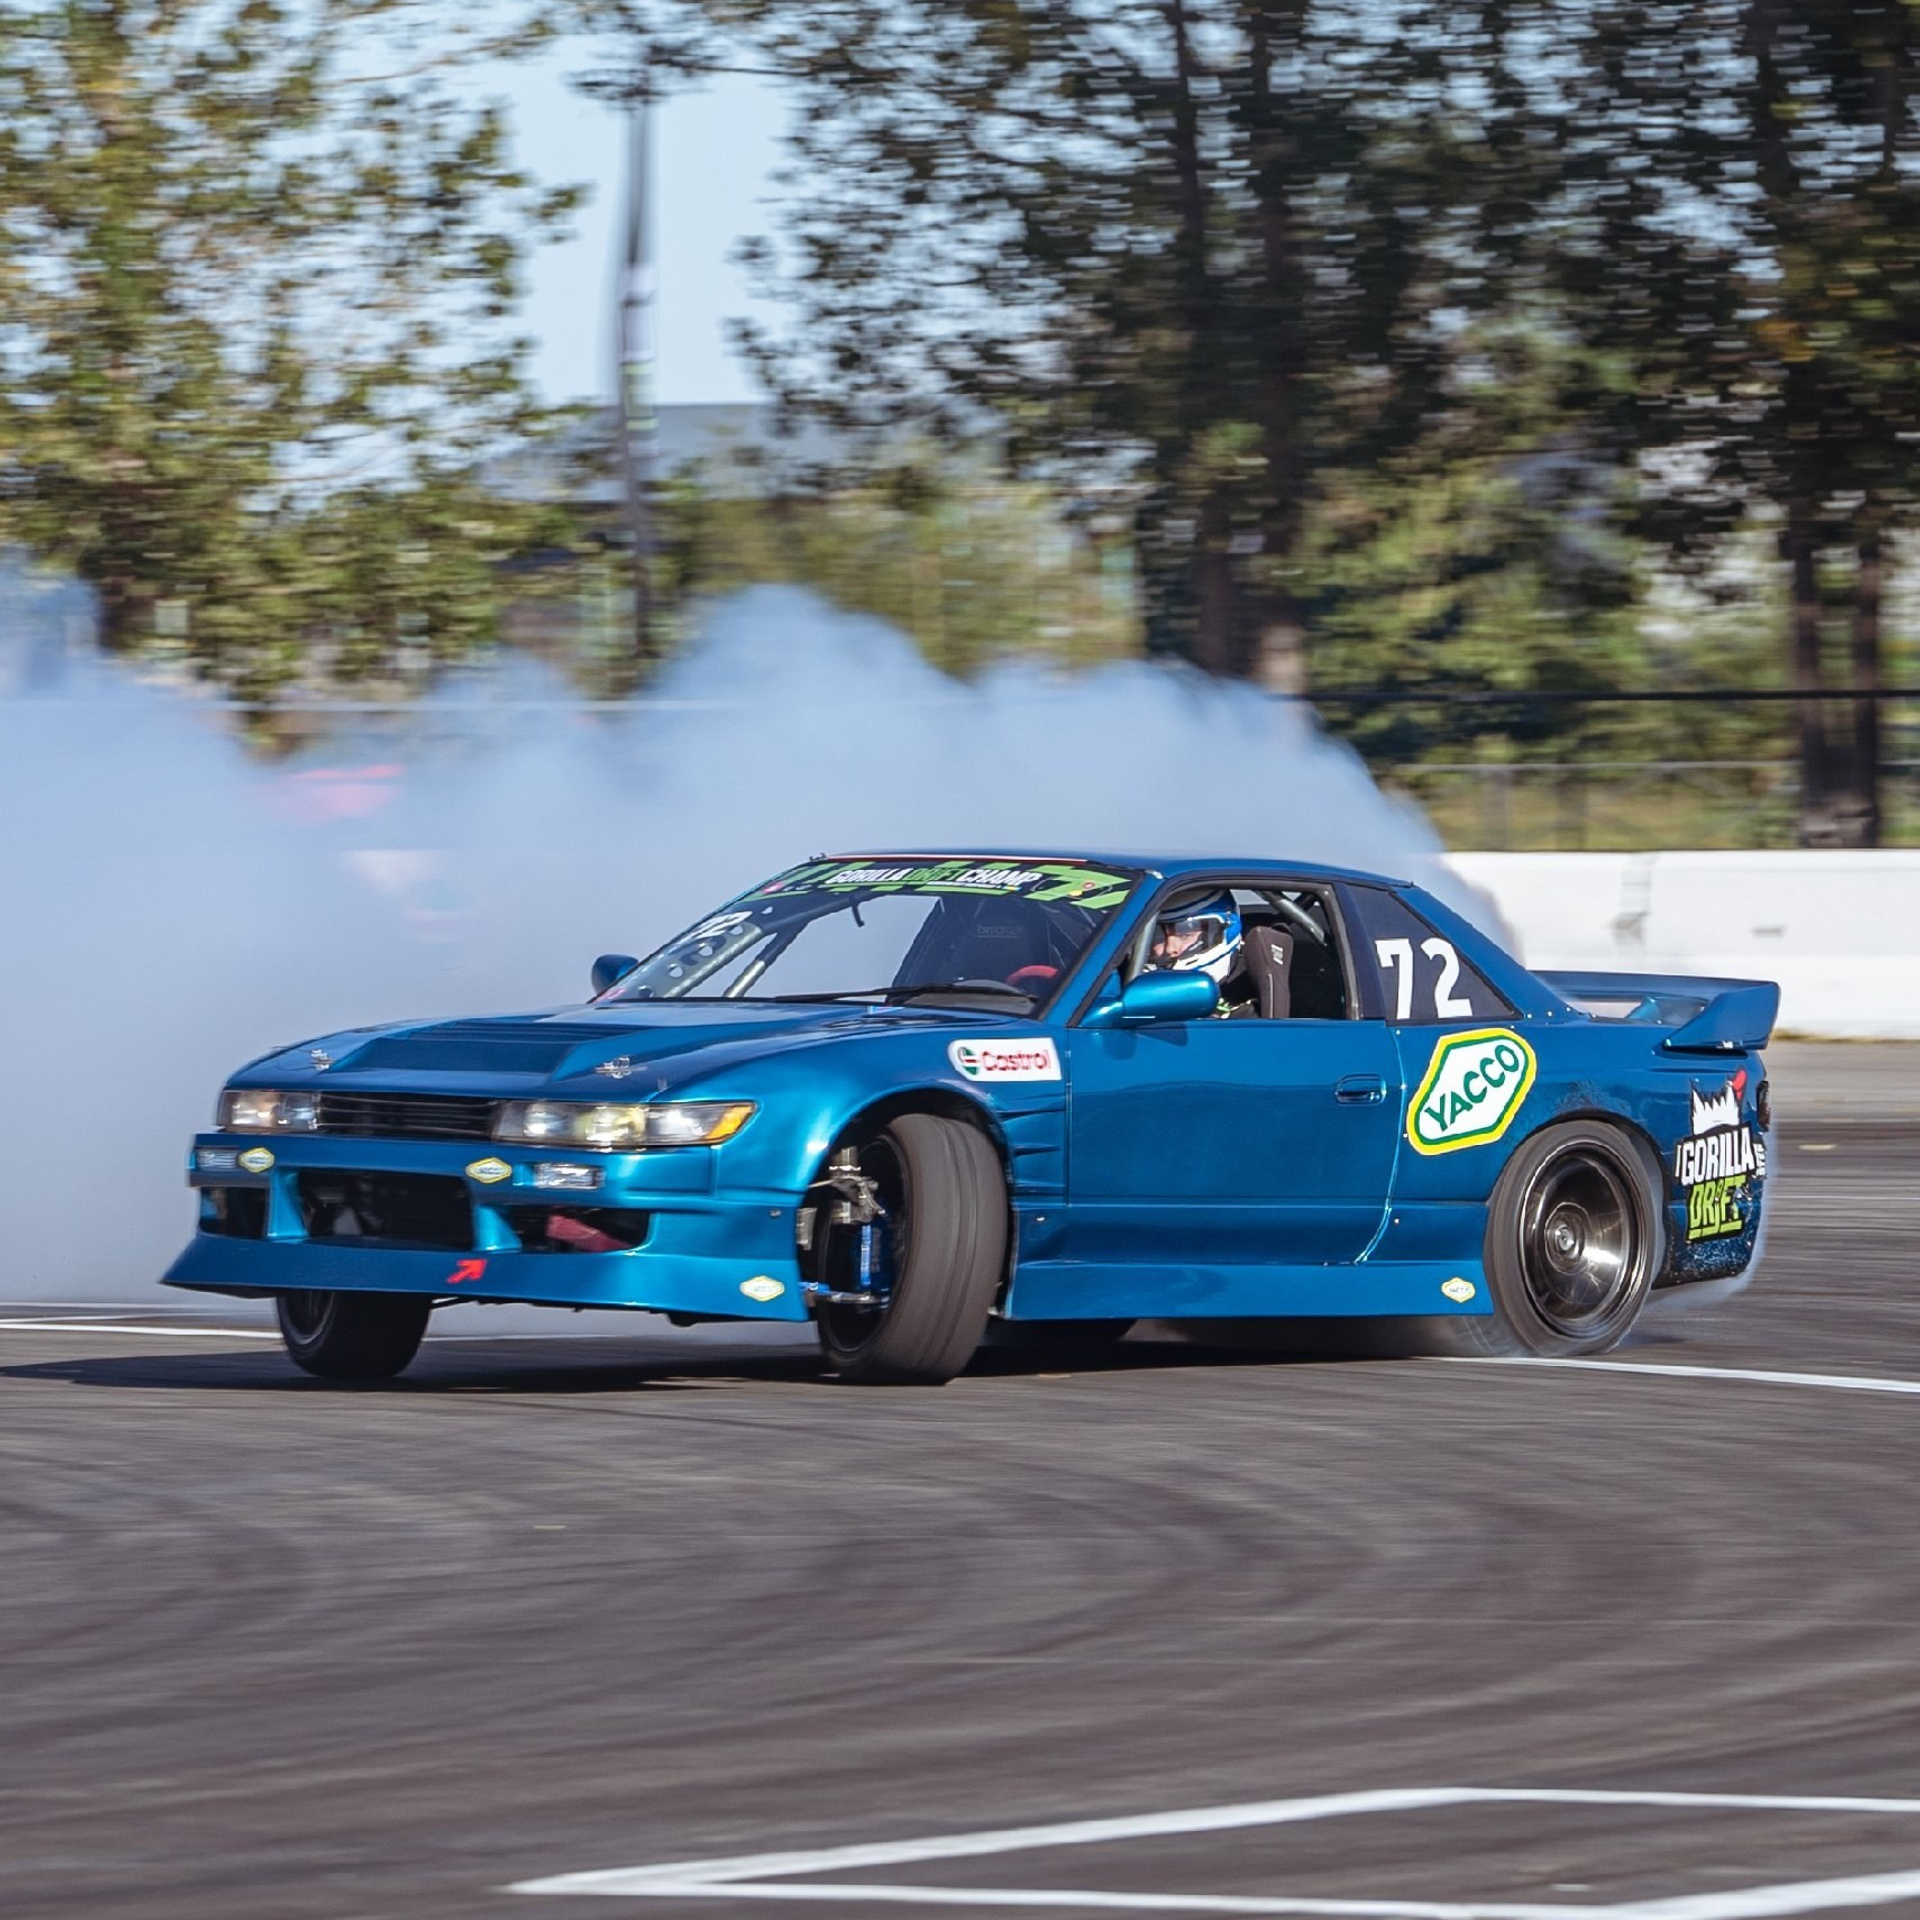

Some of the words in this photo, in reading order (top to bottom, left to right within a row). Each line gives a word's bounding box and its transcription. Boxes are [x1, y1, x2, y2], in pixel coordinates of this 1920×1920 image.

[1375, 937, 1473, 1019] 72
[981, 1049, 1051, 1071] Castrol
[1424, 1044, 1519, 1132] YACCO
[1681, 1127, 1755, 1185] GORILLA
